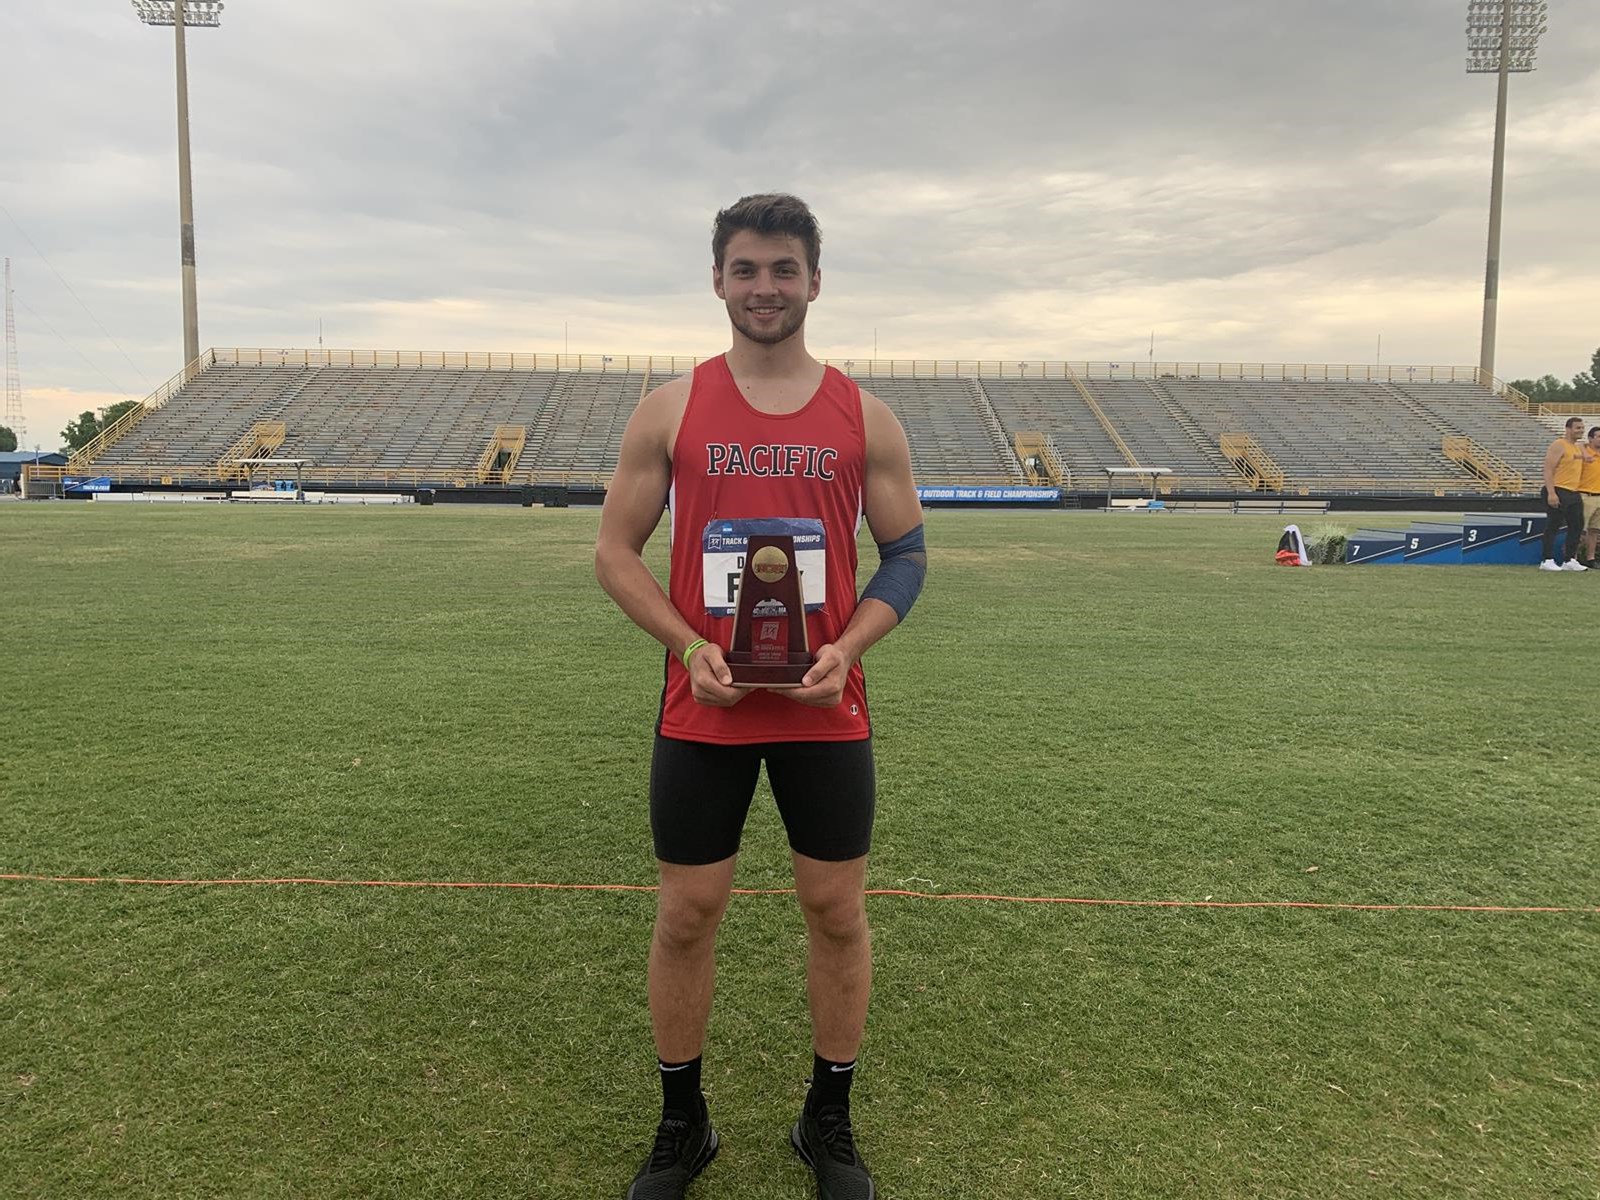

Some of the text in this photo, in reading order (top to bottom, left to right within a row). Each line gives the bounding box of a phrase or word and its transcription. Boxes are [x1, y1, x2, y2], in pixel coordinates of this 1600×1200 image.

[706, 443, 838, 481] PACIFIC
[923, 490, 954, 498] OUTDOOR
[956, 490, 977, 498] TRACK
[977, 490, 983, 498] &
[984, 490, 1001, 498] FIELD
[1003, 490, 1058, 498] CHAMPIONSHIPS
[1525, 520, 1532, 534] 1
[722, 537, 742, 545] TRACK
[1468, 529, 1477, 542] 3
[1410, 538, 1419, 549] 5
[1352, 546, 1360, 556] 7
